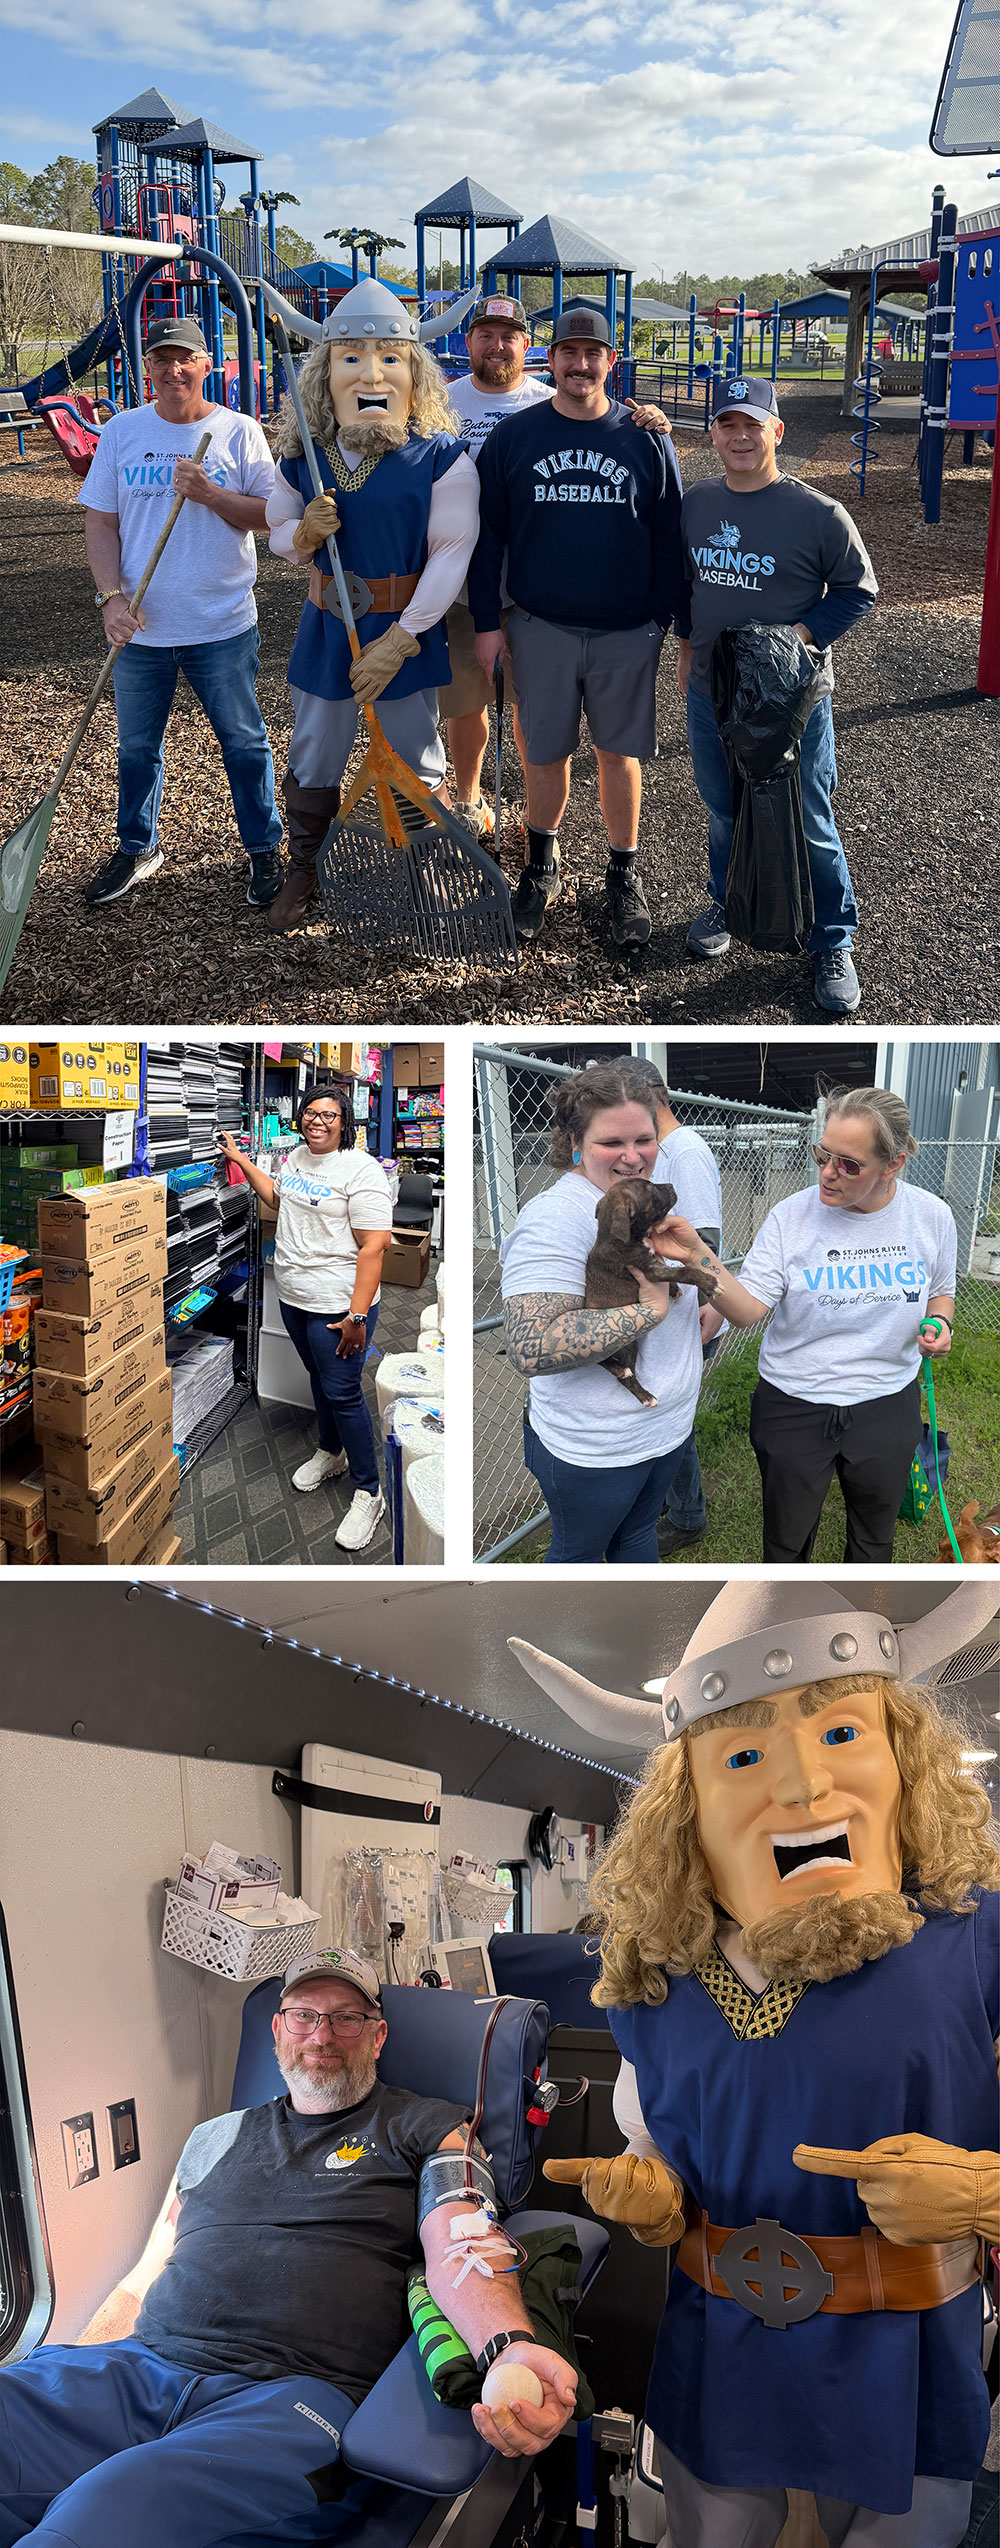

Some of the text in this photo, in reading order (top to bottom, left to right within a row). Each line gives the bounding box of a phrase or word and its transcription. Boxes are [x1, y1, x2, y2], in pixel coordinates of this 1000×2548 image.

[460, 427, 490, 439] Coun
[461, 418, 496, 430] Putna
[533, 449, 629, 485] VIKINGS
[124, 466, 227, 489] VIKIS
[534, 484, 626, 503] BASEBALL
[691, 547, 776, 576] VIKINGS
[699, 569, 763, 591] BASEBALL
[10, 1101, 26, 1109] FOR
[105, 1131, 132, 1140] Construction
[854, 1247, 880, 1256] JOHNS
[803, 1261, 926, 1291] VIKINGS
[818, 1292, 902, 1310] Days of Service
